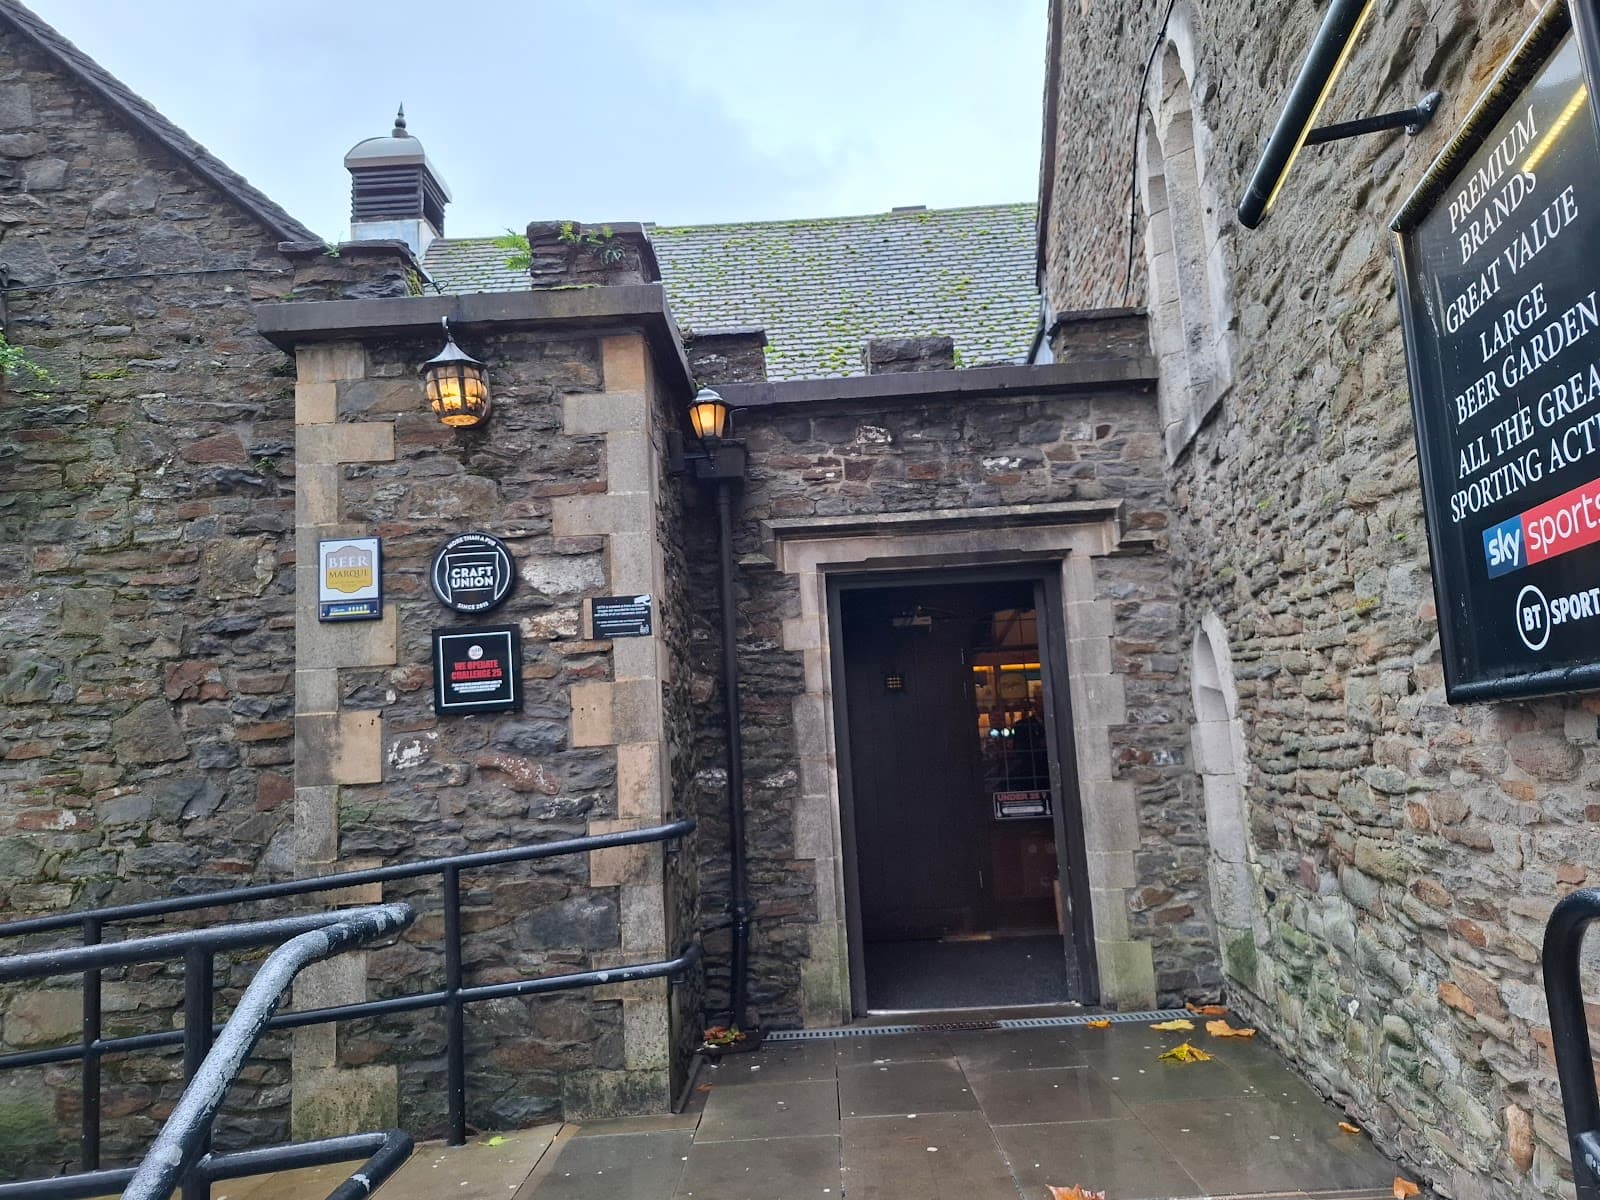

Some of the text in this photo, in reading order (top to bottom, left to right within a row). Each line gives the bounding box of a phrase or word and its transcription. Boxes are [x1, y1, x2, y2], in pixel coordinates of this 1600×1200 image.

[1448, 104, 1538, 234] PREMIUM
[1459, 170, 1537, 265] BRANDS
[1446, 185, 1578, 333] GREAT VALUE
[1480, 282, 1548, 363] LARGE
[1456, 291, 1599, 425] BEER GARDEN
[1459, 436, 1491, 479] ALL
[1491, 405, 1535, 456] THE
[1450, 448, 1543, 523] SPORTING
[329, 555, 368, 568] BEER
[1488, 527, 1521, 567] sky
[329, 568, 368, 579] MARQUE
[451, 566, 493, 578] CRAFT
[451, 576, 493, 588] UNION
[457, 602, 475, 610] SINCE
[1522, 587, 1600, 631] BT SPORT
[451, 668, 502, 680] CHALLENGE 25
[467, 660, 499, 669] OPERATE
